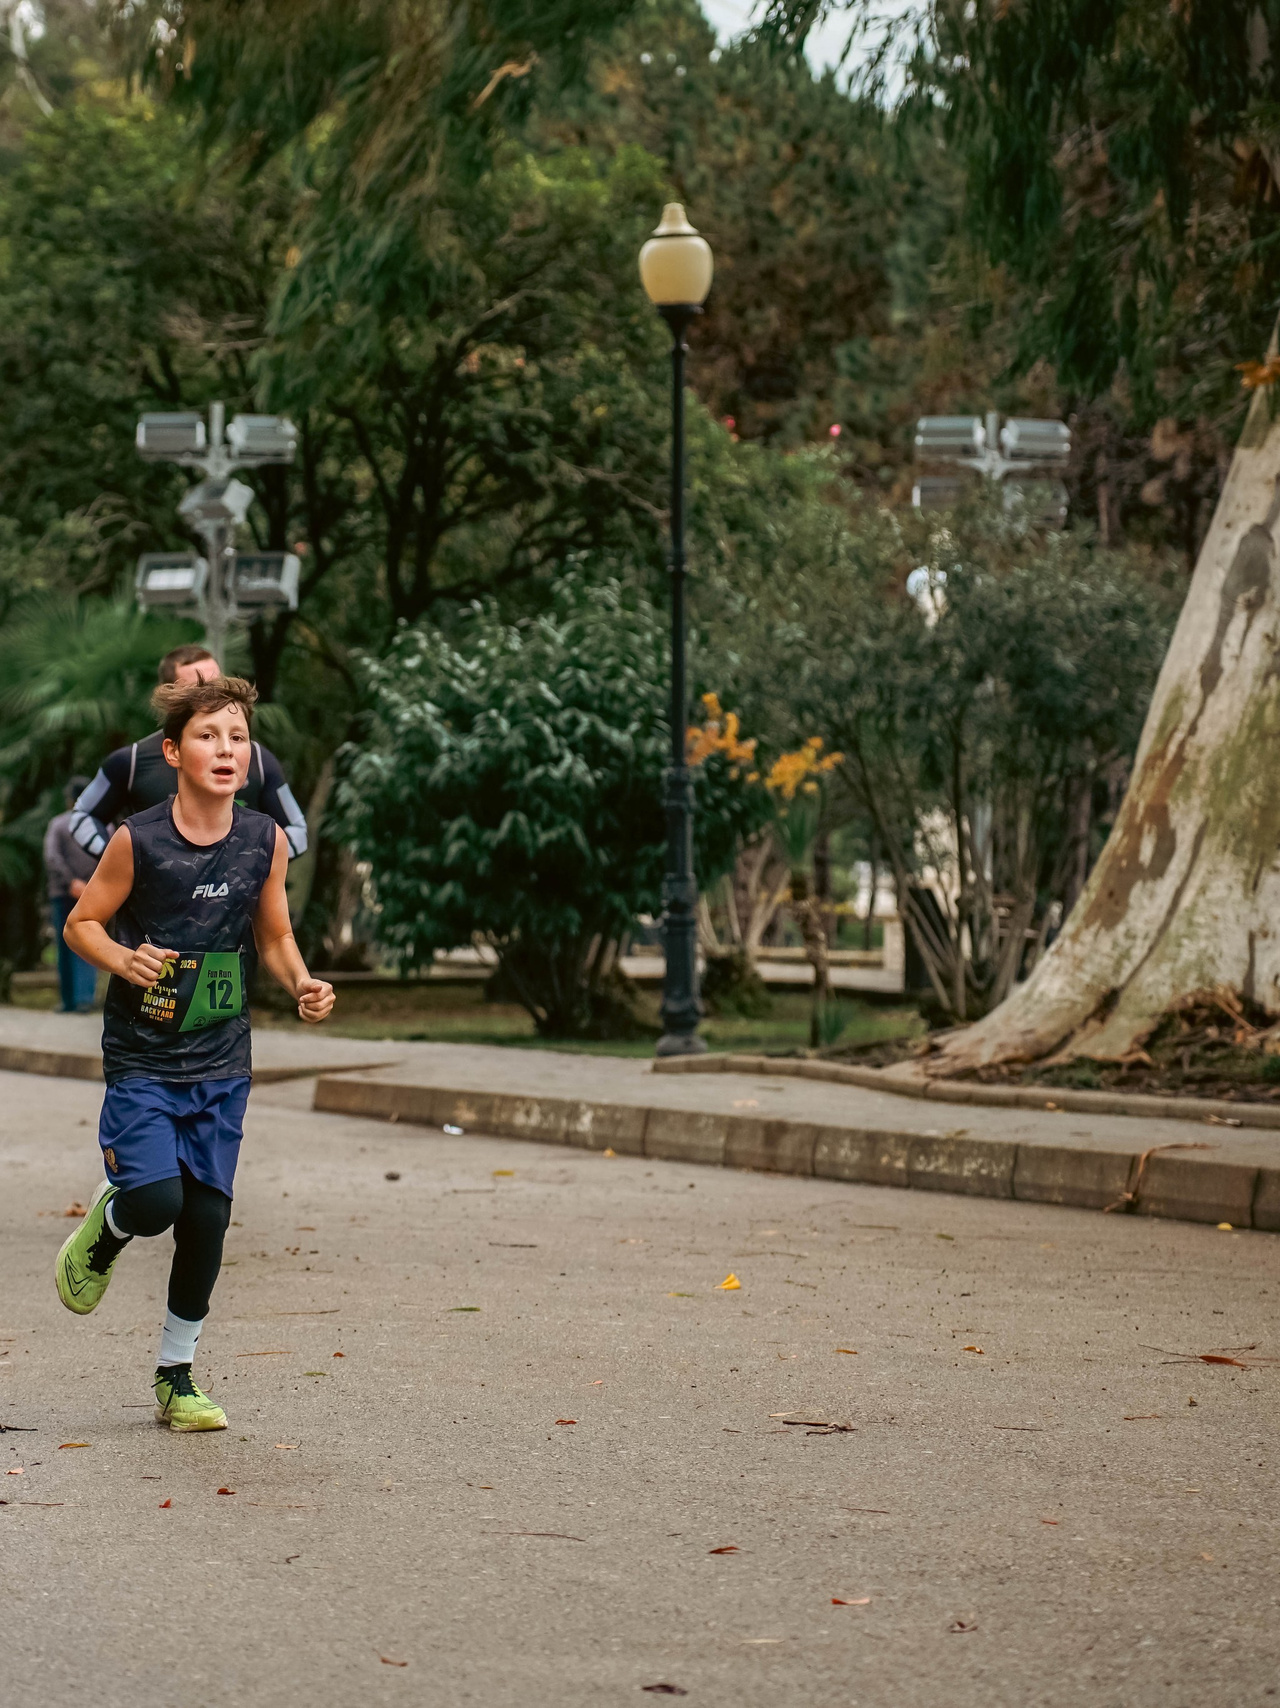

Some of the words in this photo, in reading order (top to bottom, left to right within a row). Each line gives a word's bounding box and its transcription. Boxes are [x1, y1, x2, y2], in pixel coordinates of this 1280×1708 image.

[192, 882, 230, 899] FILA
[179, 959, 197, 969] 2025
[207, 969, 218, 978] Fun
[219, 970, 232, 978] Run
[143, 993, 176, 1010] WORLD
[206, 979, 234, 1010] 12
[140, 1005, 174, 1019] BACKYARD
